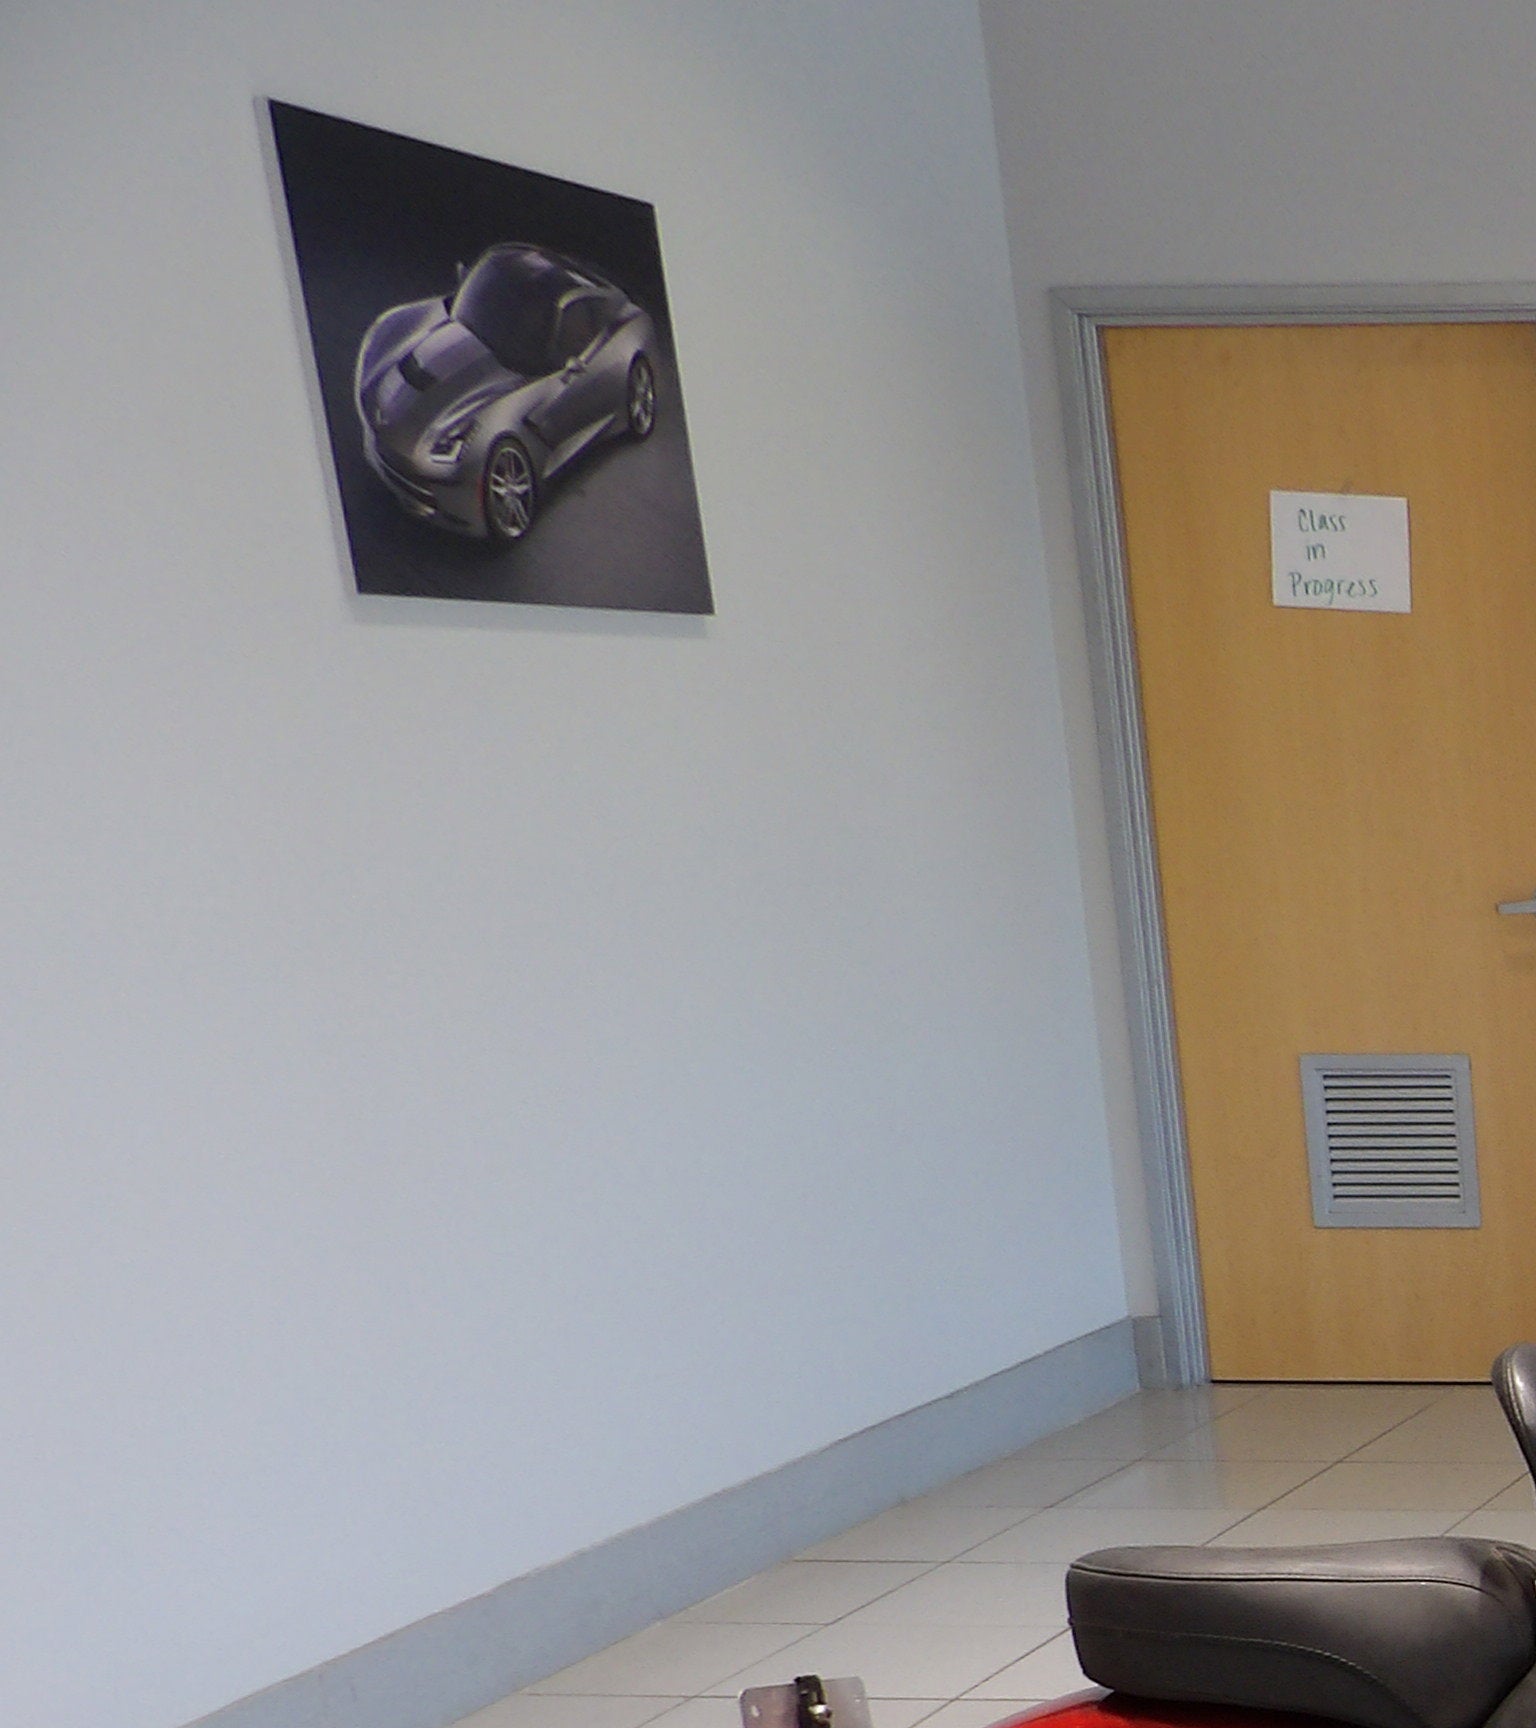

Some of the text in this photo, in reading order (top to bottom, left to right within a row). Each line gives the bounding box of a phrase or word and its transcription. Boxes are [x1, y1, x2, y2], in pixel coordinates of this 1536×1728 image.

[1298, 508, 1348, 532] Class
[1306, 542, 1326, 561] in
[1288, 571, 1379, 605] Progress
